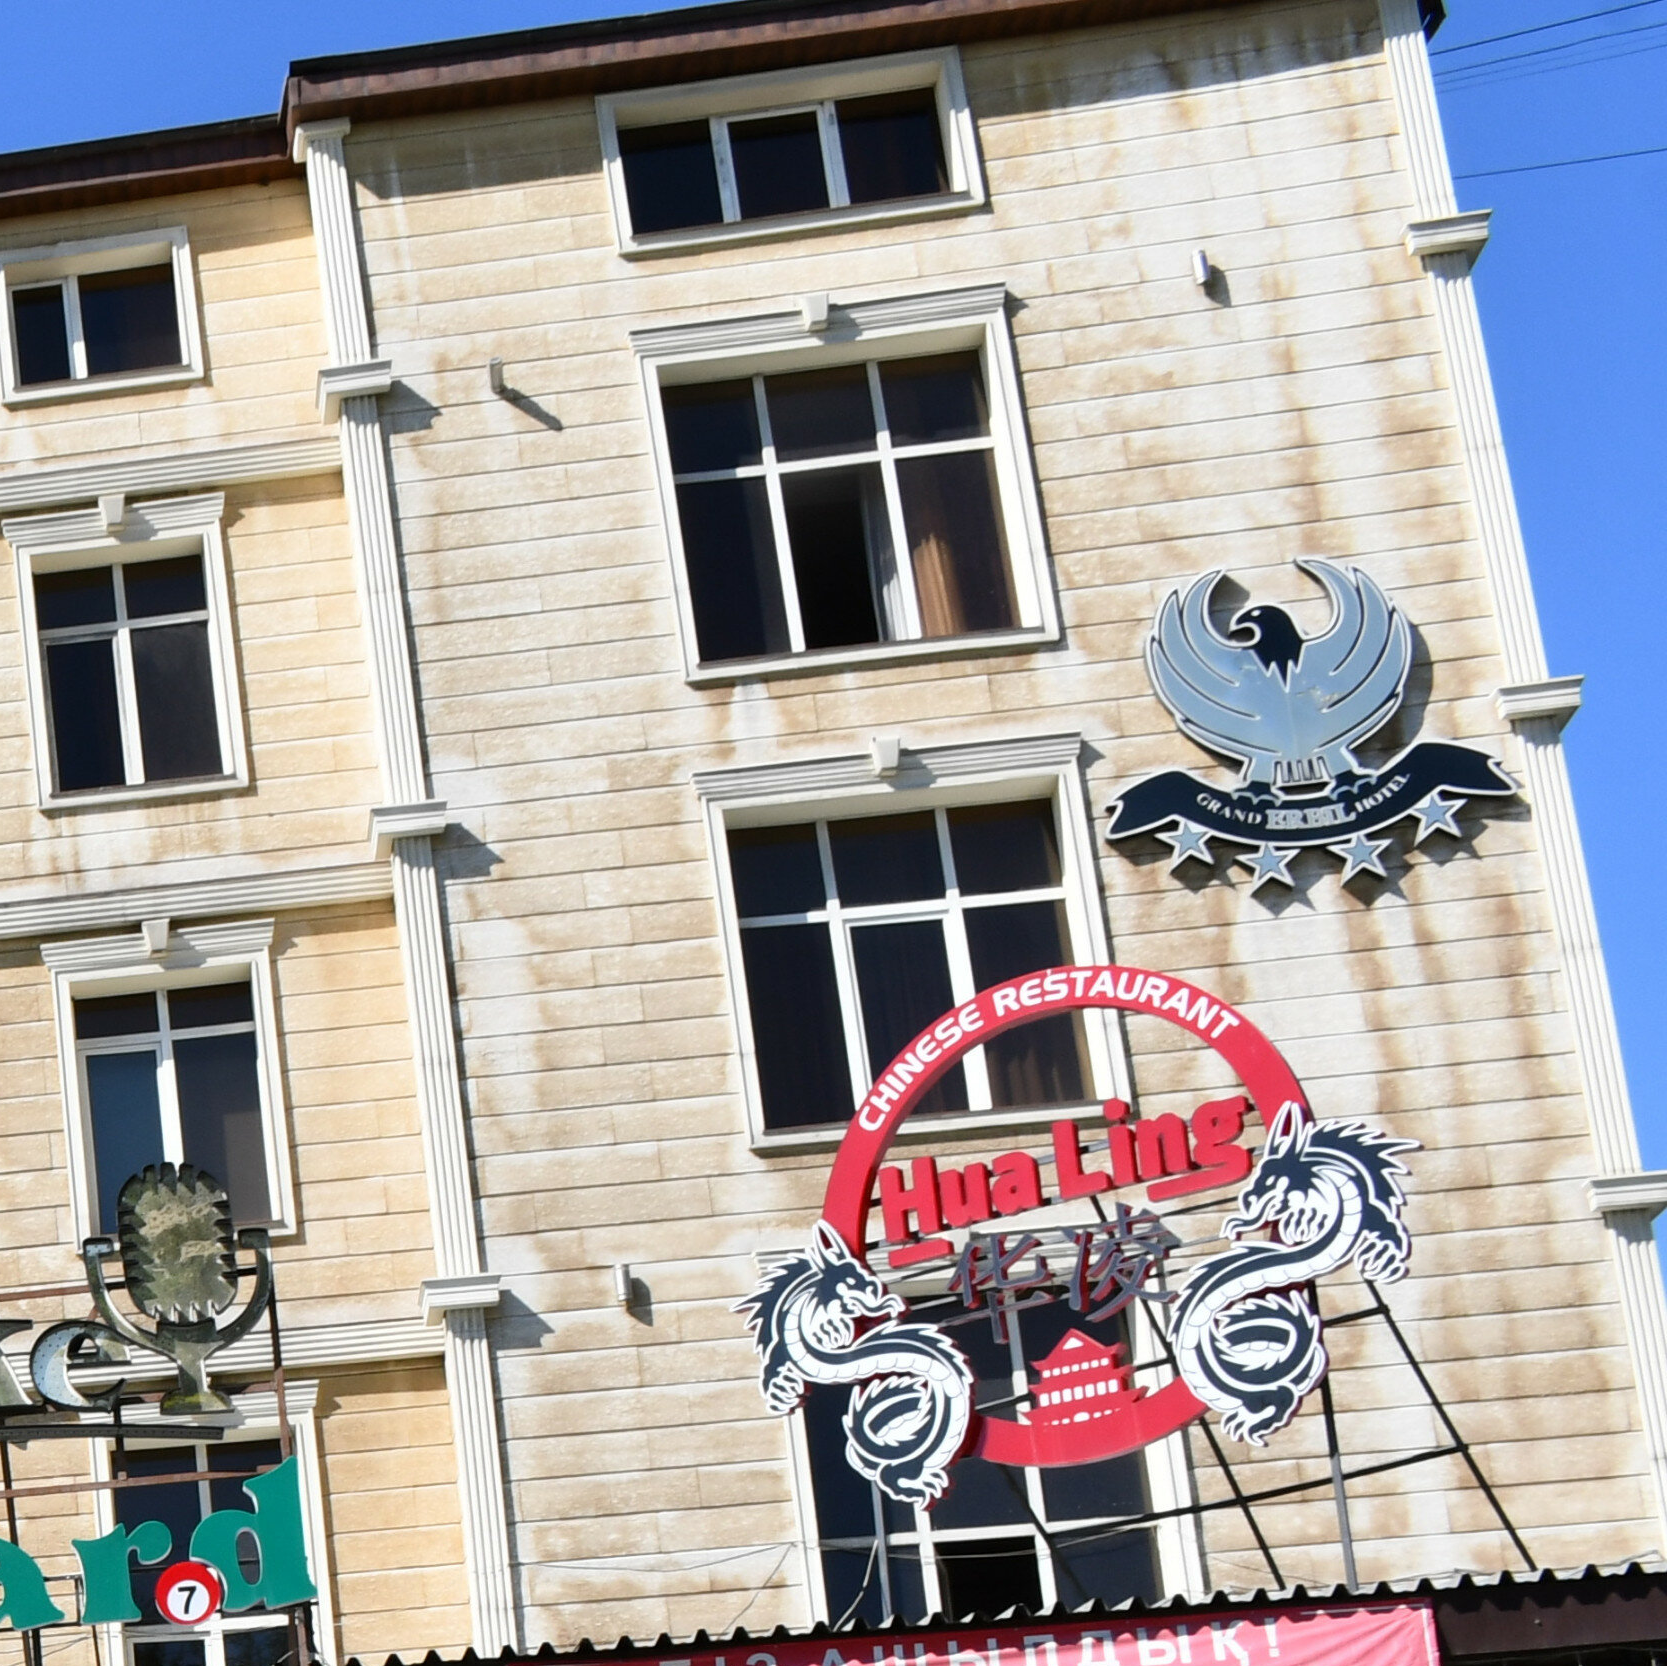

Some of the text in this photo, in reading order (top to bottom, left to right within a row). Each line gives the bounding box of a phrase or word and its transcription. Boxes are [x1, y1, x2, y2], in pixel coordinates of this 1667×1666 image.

[1196, 773, 1411, 831] GRAND ERBIL HOTEL
[858, 968, 1239, 1132] CHINESE RESTAURANT
[878, 1098, 1255, 1268] Hua Ling
[947, 1202, 1179, 1344] 华凌
[177, 1586, 198, 1614] 7
